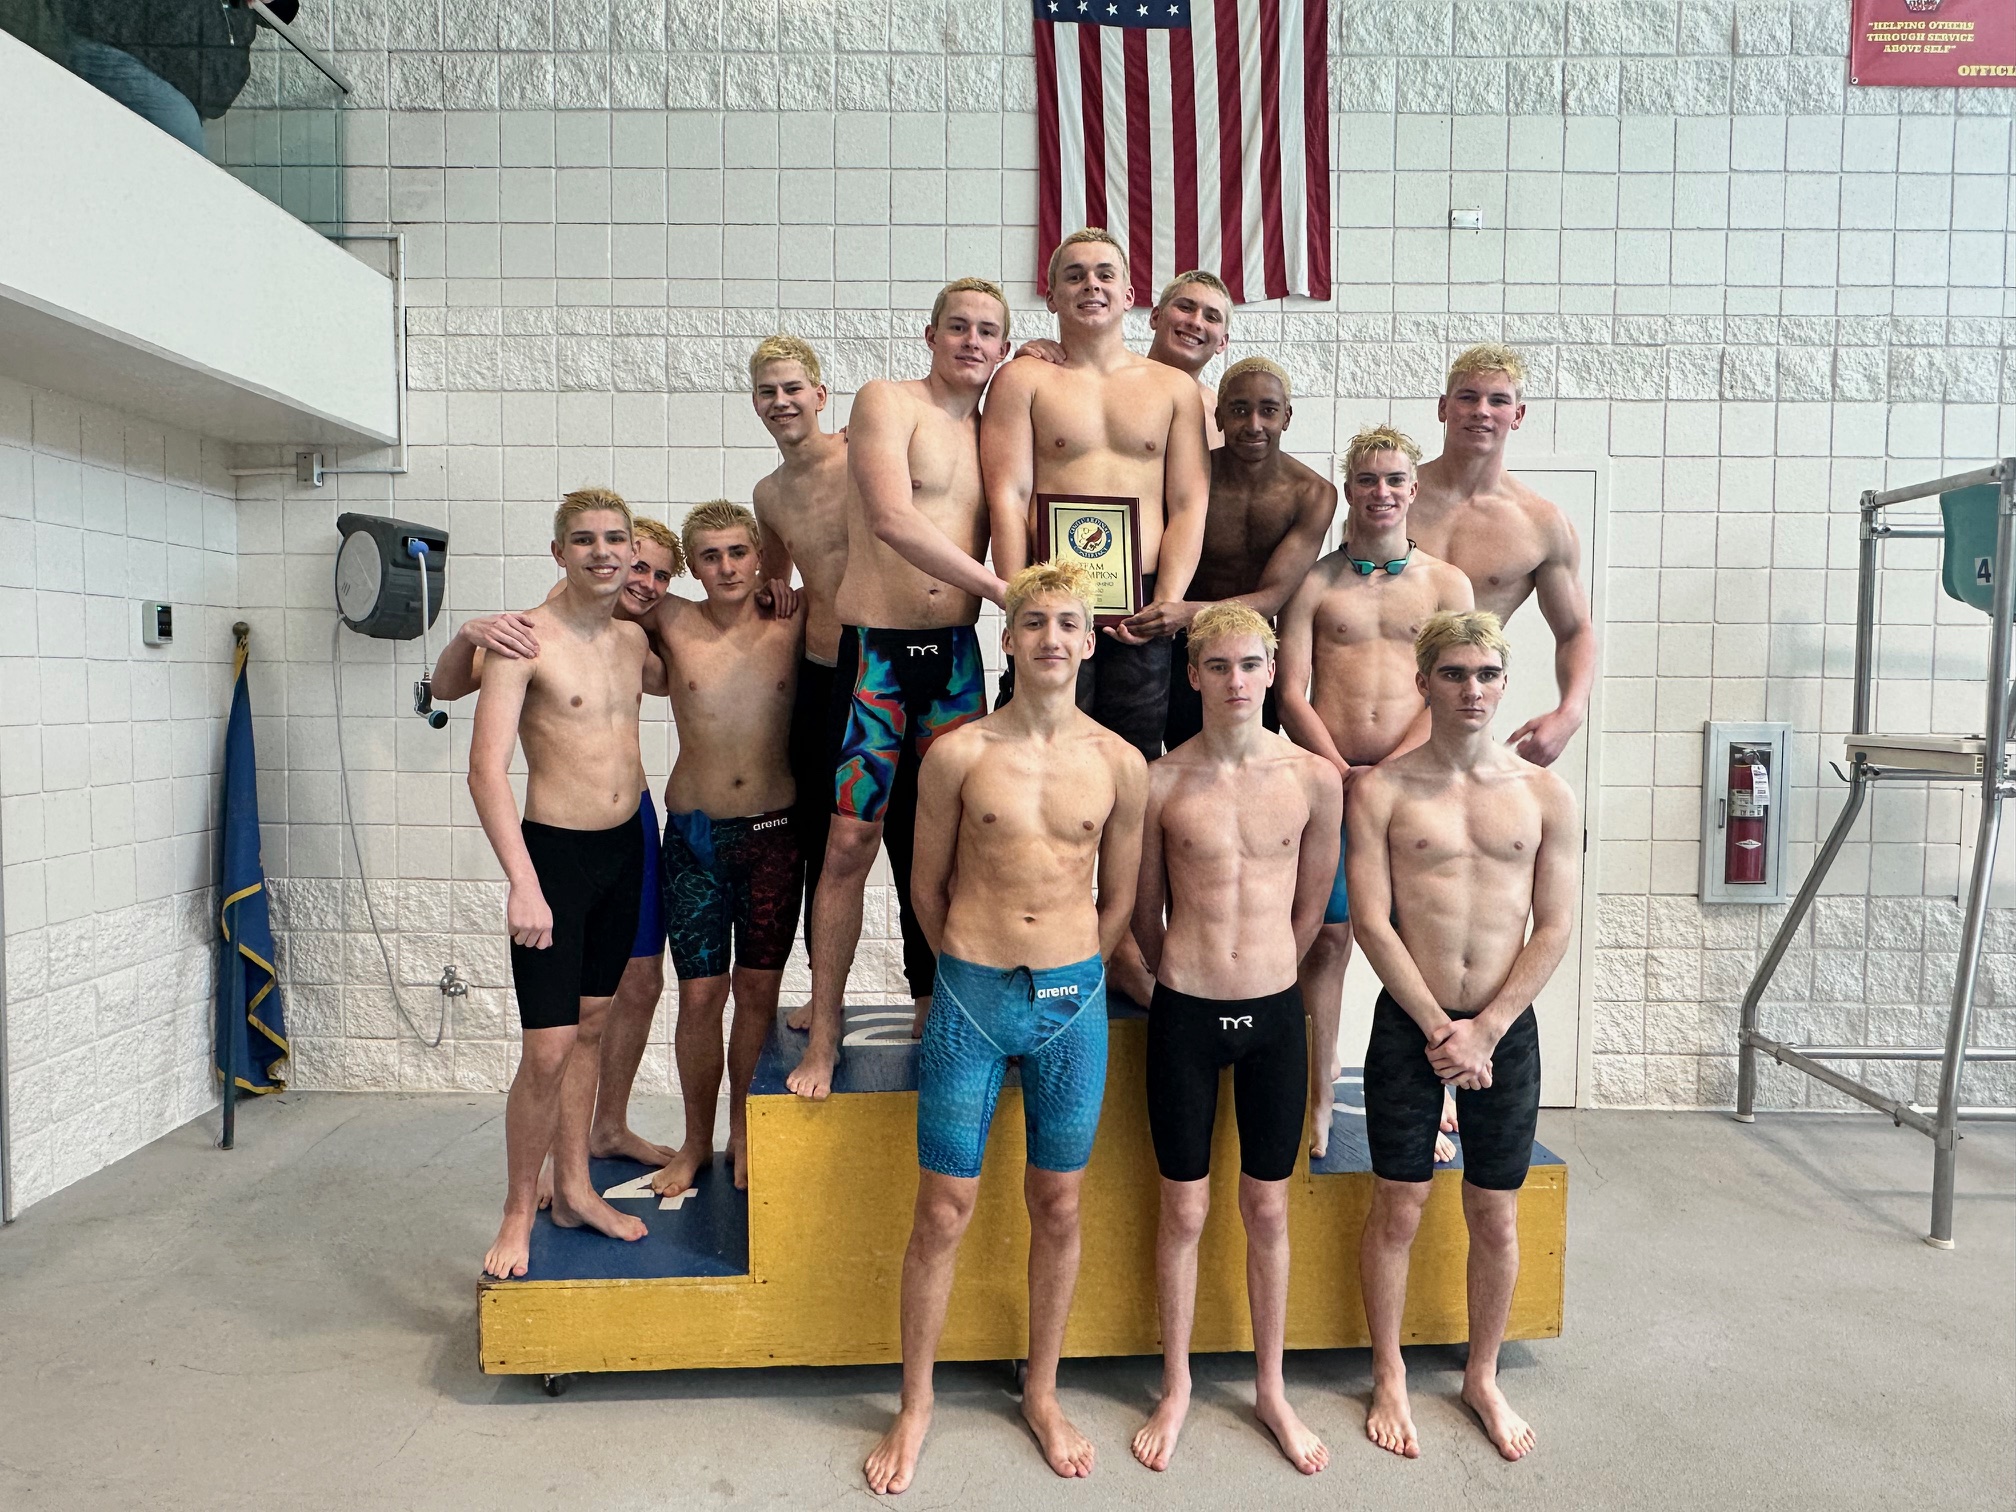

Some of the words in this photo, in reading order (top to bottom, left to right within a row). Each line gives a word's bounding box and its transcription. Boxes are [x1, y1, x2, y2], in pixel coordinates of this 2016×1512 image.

[1928, 21, 1975, 30] OTHERS
[1866, 33, 1925, 42] THROUGH
[1927, 33, 1975, 42] SERVICE
[1883, 45, 1922, 53] ABOVE
[1977, 558, 1992, 583] 4
[906, 644, 939, 657] TYR
[753, 817, 788, 831] arena
[1037, 984, 1078, 999] arena
[1218, 1015, 1253, 1030] TYR
